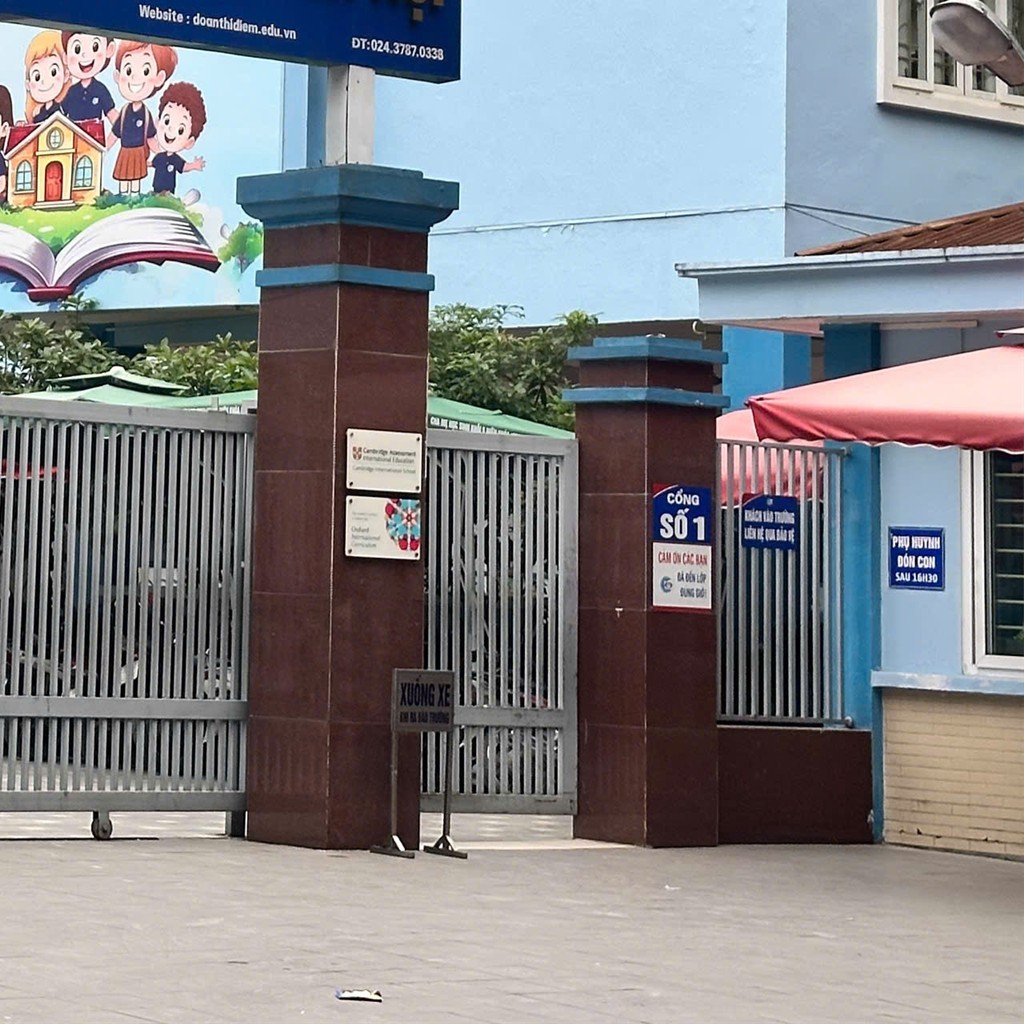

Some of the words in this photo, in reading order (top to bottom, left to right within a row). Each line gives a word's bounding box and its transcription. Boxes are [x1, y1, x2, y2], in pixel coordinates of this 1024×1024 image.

[139, 4, 183, 24] Website
[193, 12, 296, 40] doanthidiem.edu.vn
[667, 489, 700, 506] CỔNG
[659, 508, 689, 540] SỐ
[693, 516, 705, 541] 1
[892, 536, 910, 551] PHỤ
[911, 536, 940, 549] HUYNH
[897, 553, 916, 568] ĐÓN
[917, 556, 936, 569] CON
[895, 572, 911, 582] SAU
[912, 573, 938, 583] 16H30
[400, 675, 435, 707] XUỐNG
[437, 683, 451, 707] XE
